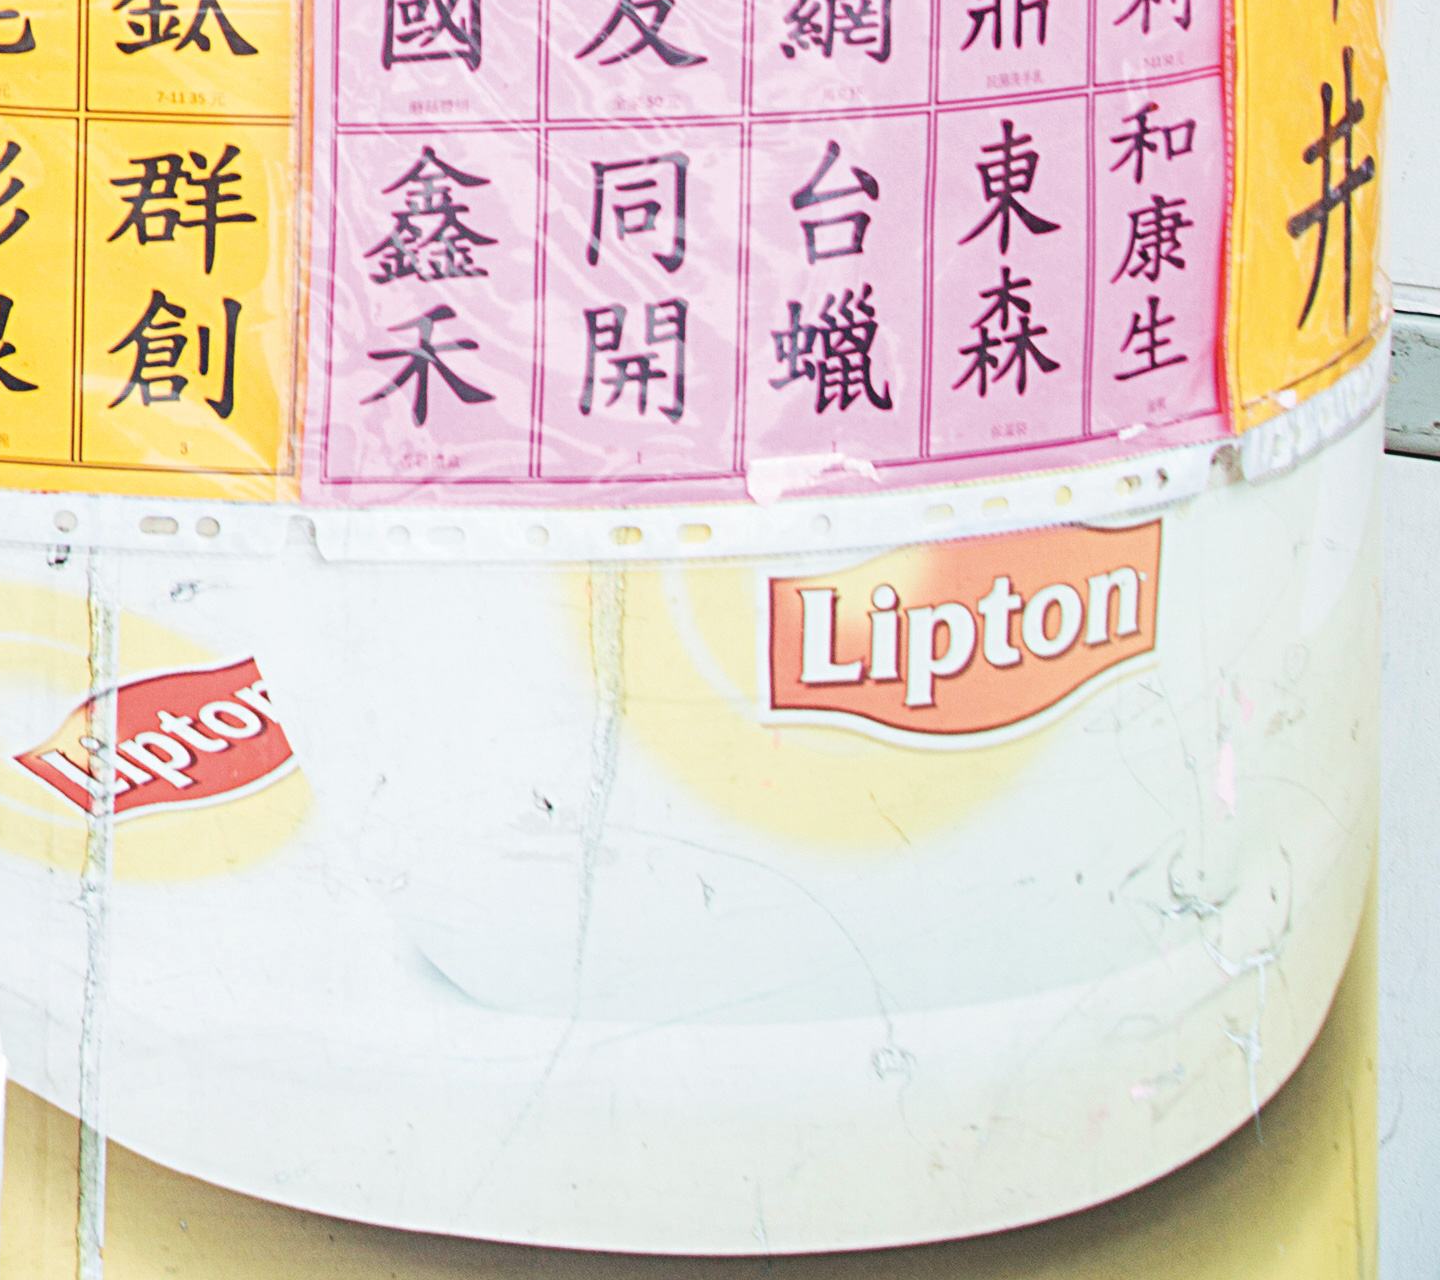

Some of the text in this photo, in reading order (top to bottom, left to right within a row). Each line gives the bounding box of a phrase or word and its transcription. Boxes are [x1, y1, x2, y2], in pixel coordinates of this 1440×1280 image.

[107, 142, 258, 421] 群創
[360, 145, 499, 429] 鑫禾
[576, 151, 691, 424] 同開
[767, 140, 894, 417] 台蠟
[955, 119, 1062, 399] 東森
[1109, 101, 1198, 384] 和康生
[797, 565, 1141, 708] Lipton
